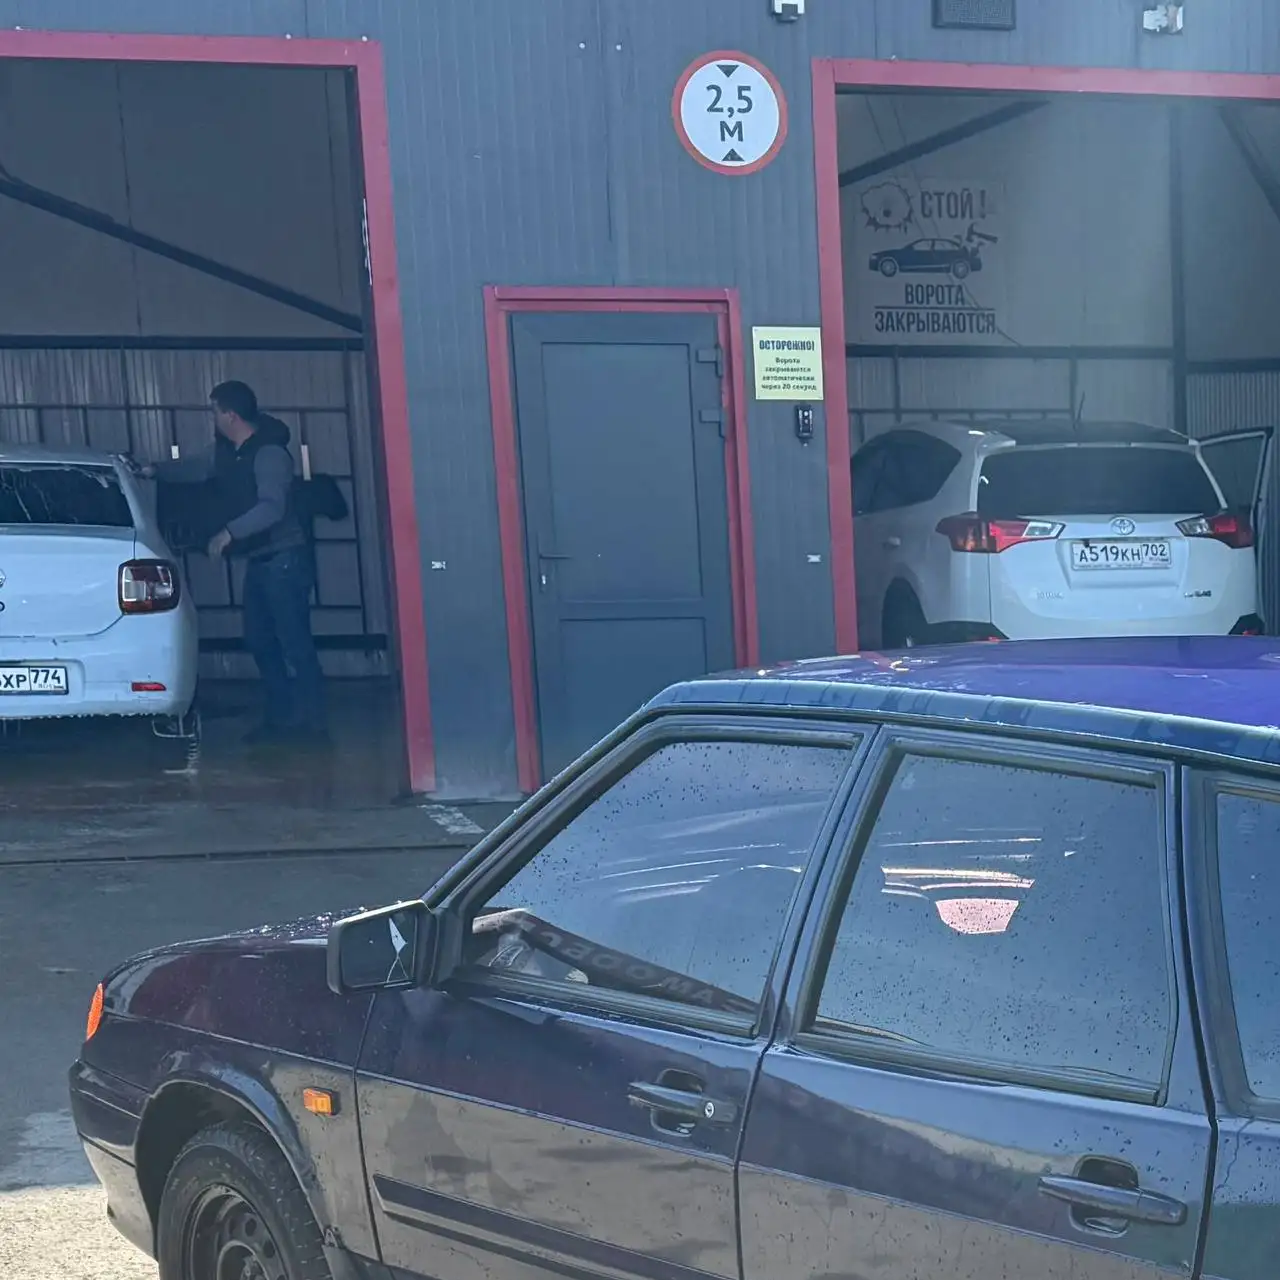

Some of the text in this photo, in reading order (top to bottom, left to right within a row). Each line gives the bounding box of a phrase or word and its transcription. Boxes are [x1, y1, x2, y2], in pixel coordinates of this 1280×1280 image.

[706, 84, 753, 118] 2,5
[920, 187, 973, 220] СТОЙ
[904, 283, 966, 306] ВОРОТА
[874, 311, 996, 334] ЗАКРЫВАЮТСЯ
[1142, 543, 1167, 557] 702
[0, 669, 62, 689] ХР 774
